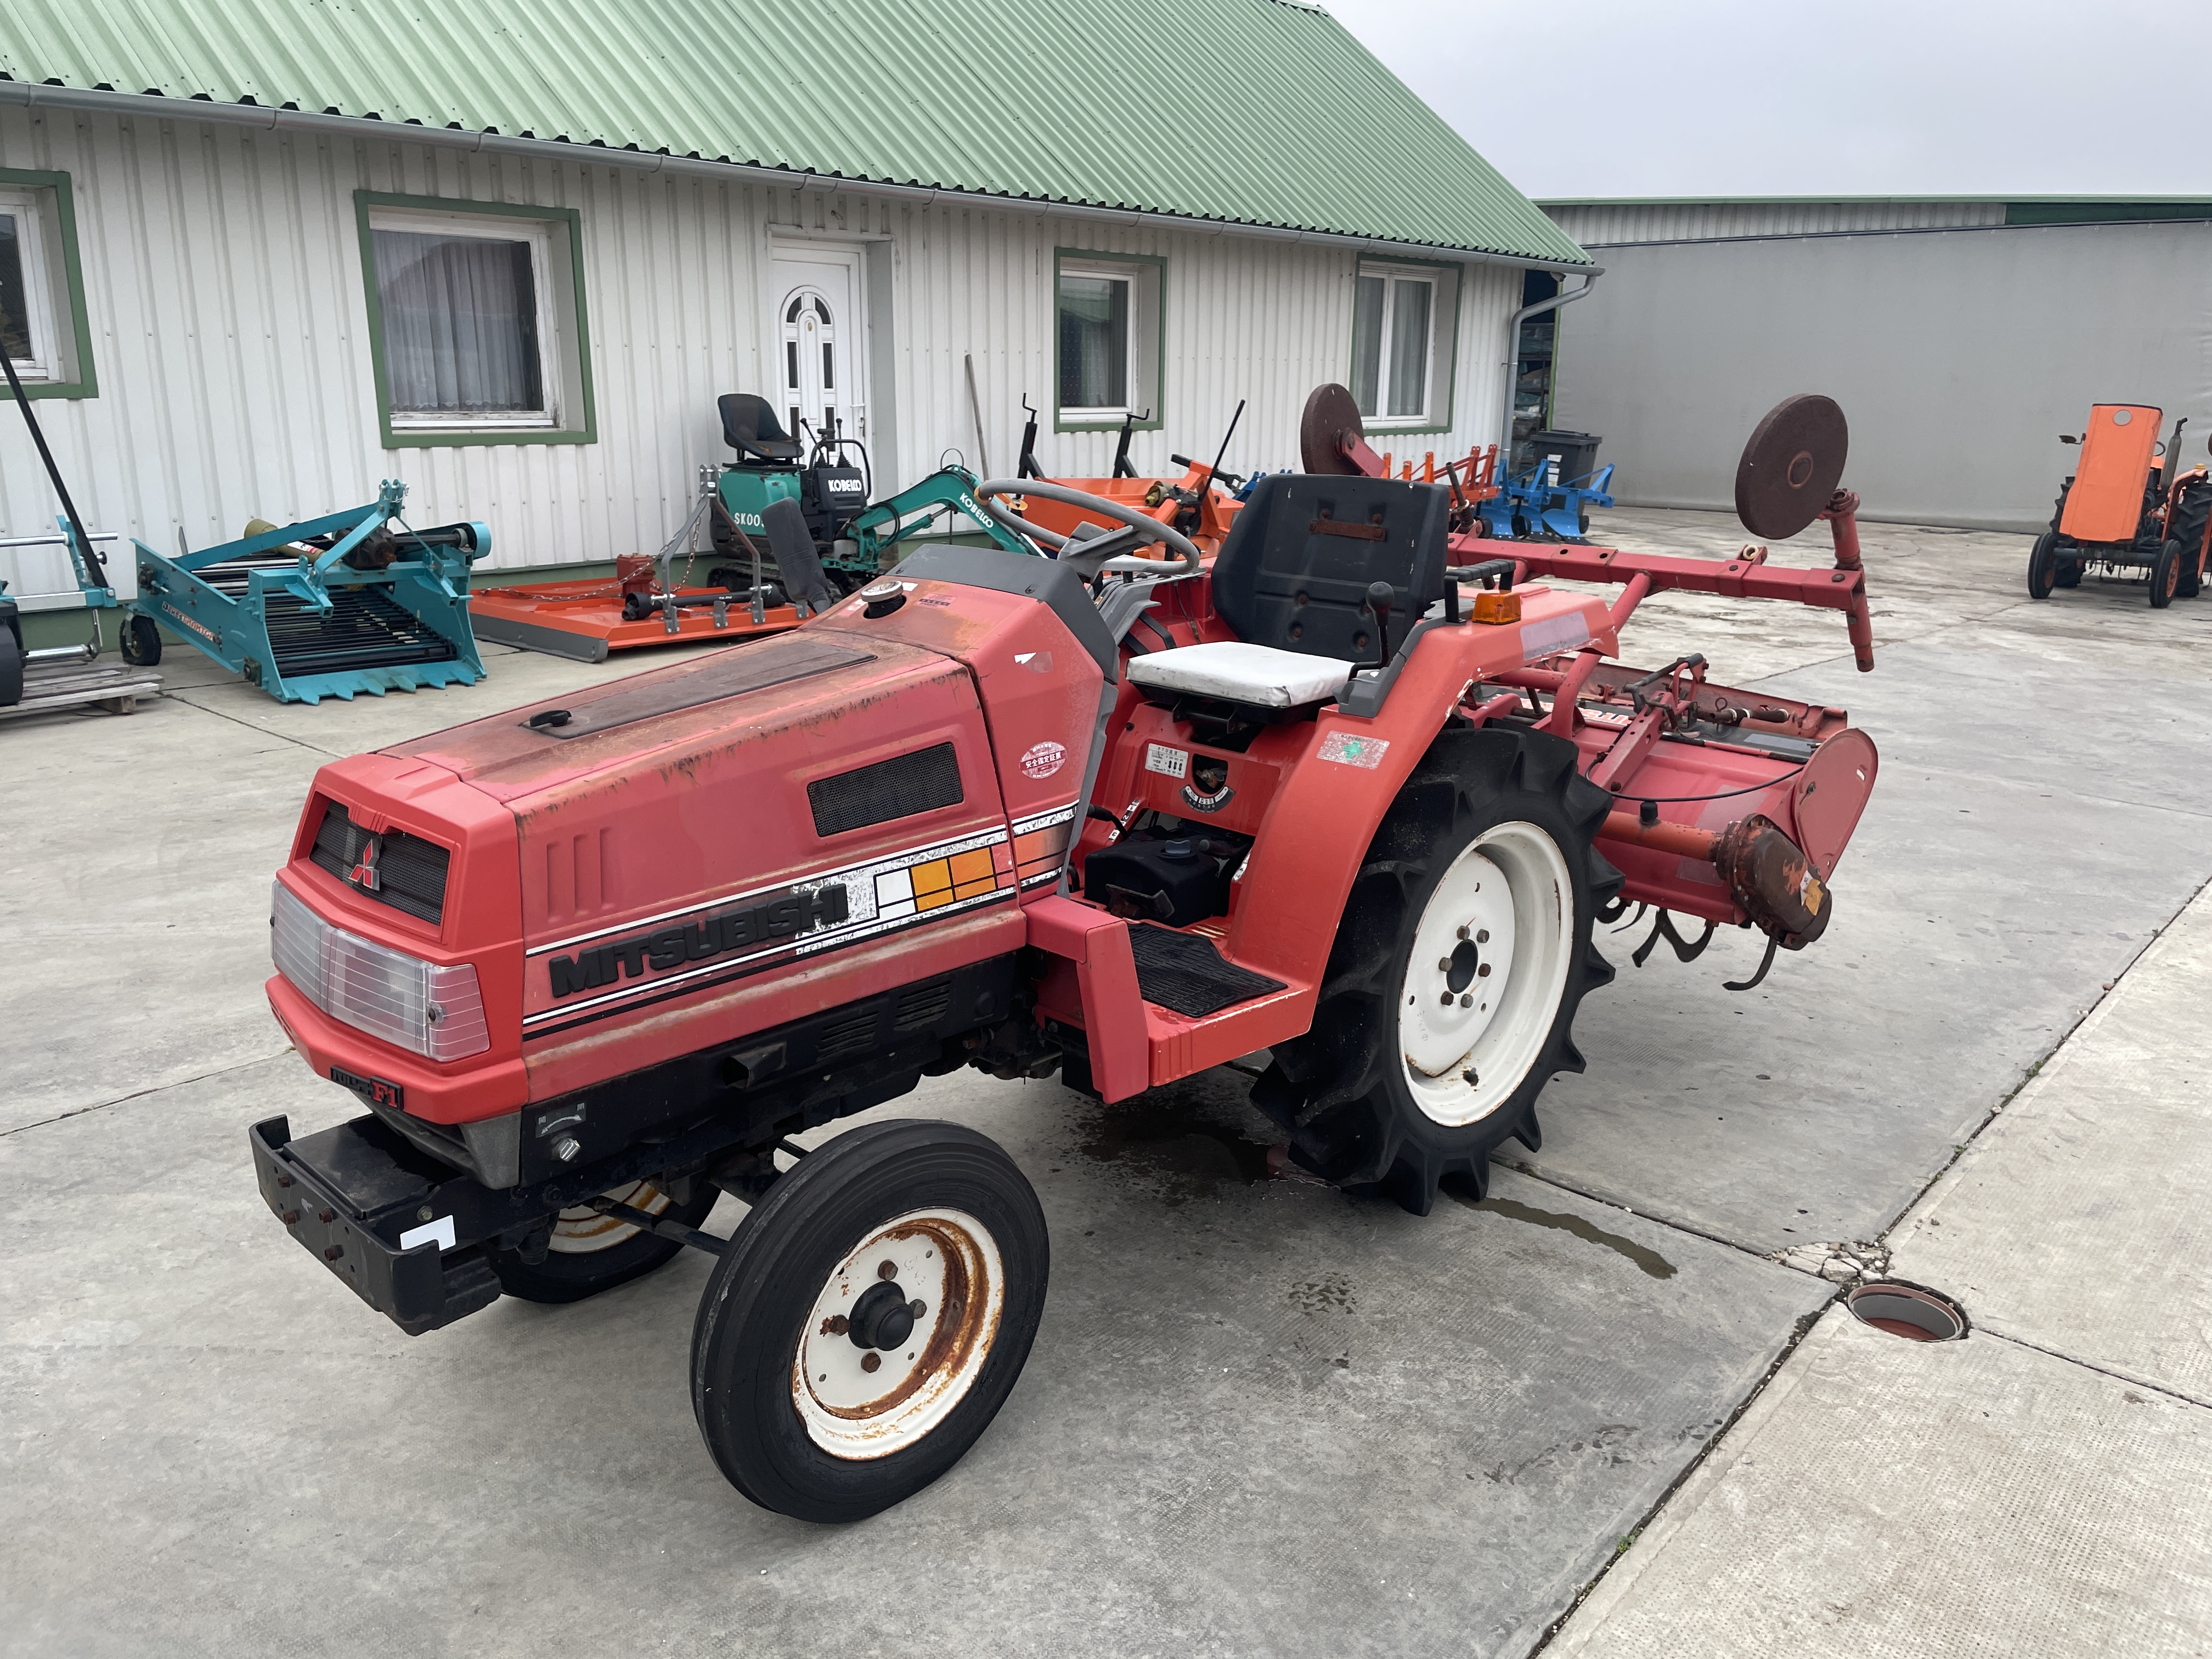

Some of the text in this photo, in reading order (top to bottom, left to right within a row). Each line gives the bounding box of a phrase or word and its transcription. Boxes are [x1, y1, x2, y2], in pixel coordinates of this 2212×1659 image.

[828, 479, 862, 492] KOBELCO
[734, 512, 764, 528] SK00
[960, 493, 994, 528] KOBELCO
[549, 883, 849, 998] MITSUBISHI
[372, 1081, 398, 1108] F1
